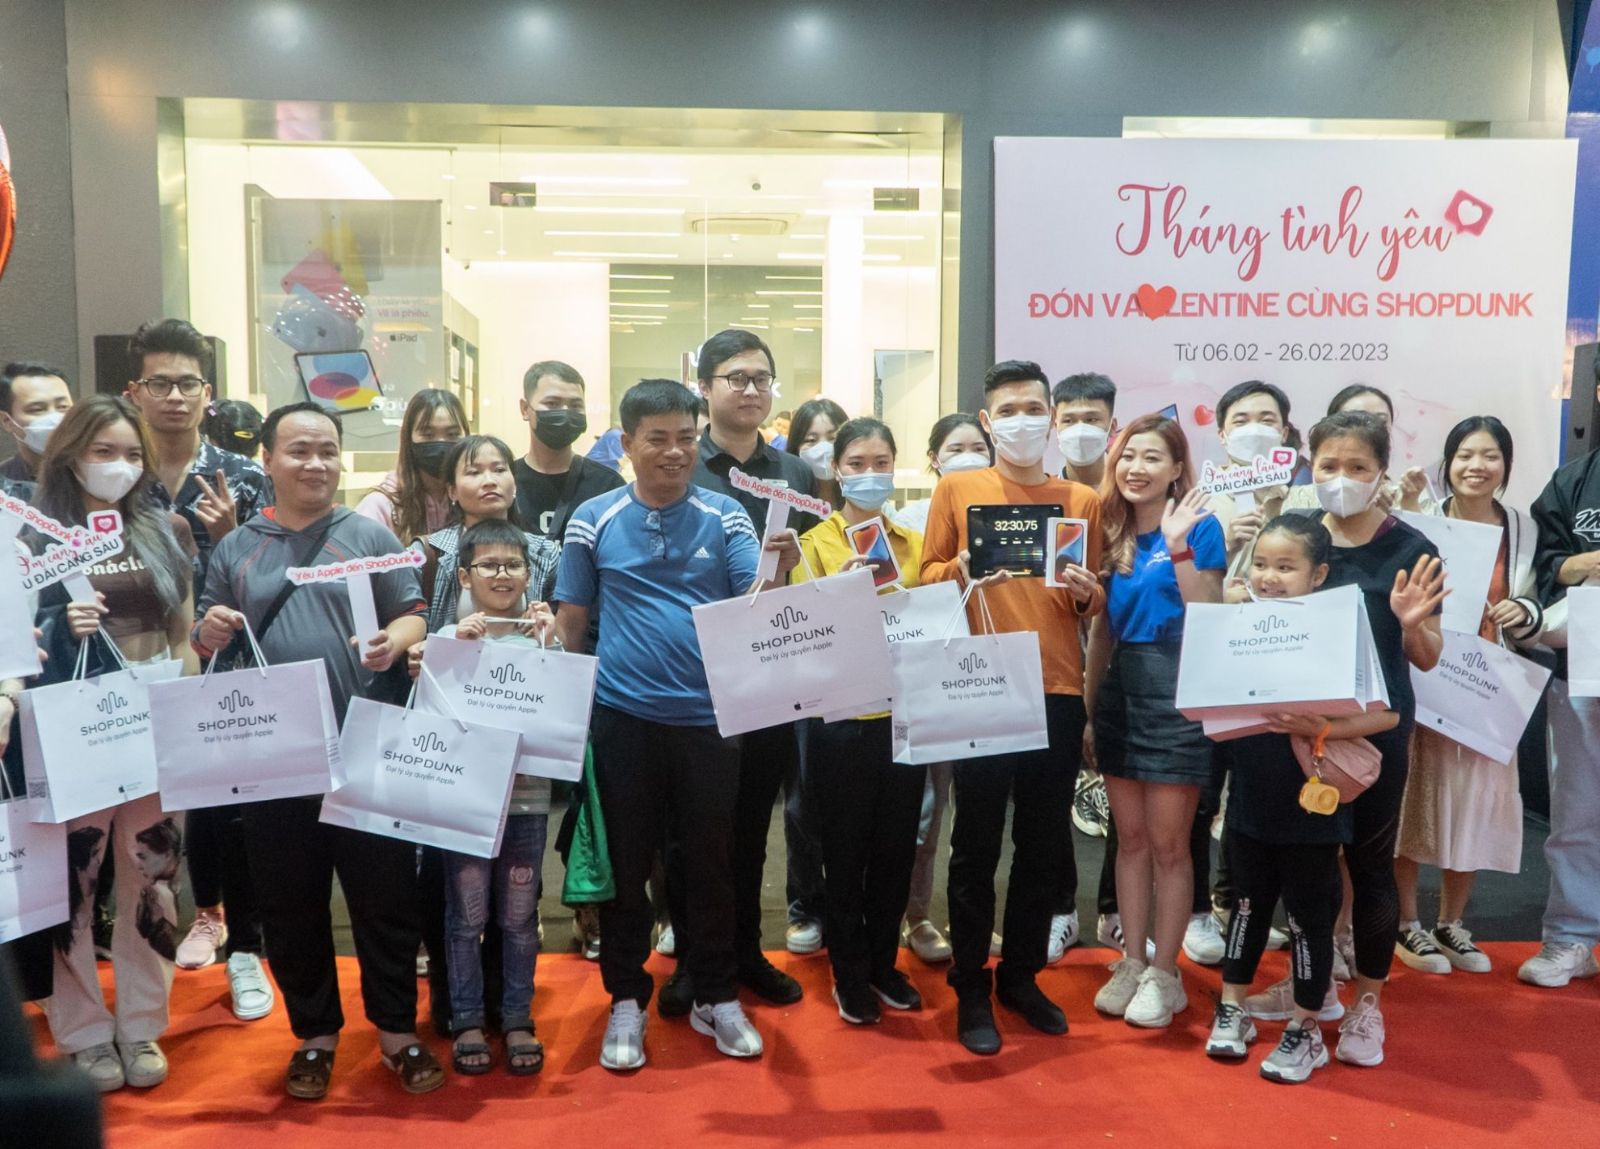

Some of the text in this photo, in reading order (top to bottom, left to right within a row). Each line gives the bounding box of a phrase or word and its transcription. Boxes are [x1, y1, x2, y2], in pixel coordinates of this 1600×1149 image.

[1115, 182, 1453, 282] Tháng tình yêu
[1028, 287, 1093, 318] ĐÓN
[1286, 286, 1369, 318] CÙNG
[1376, 292, 1534, 318] SHOPDUNK
[1173, 342, 1199, 361] Từ
[1202, 343, 1259, 361] 06.02
[1279, 343, 1390, 361] 26.02.2023
[751, 481, 772, 496] Apple
[787, 493, 824, 511] ShopDunk
[25, 510, 73, 541] ShopDunk
[317, 567, 344, 578] Apple
[365, 555, 412, 570] ShopDunk
[751, 624, 836, 653] SHOPDUNK
[887, 628, 925, 643] DUNK
[1228, 632, 1311, 648] SHOPDUNK
[812, 641, 833, 652] Apple
[941, 675, 1008, 690] SHOPDUNK
[1439, 658, 1501, 694] SHOPDUNK
[463, 684, 544, 704] SHOPDUNK
[518, 705, 538, 715] Apple
[80, 711, 151, 736] SHOPDUNK
[197, 713, 277, 732] SHOPDUNK
[383, 750, 465, 776] SHOPDUNK
[435, 775, 456, 786] Apple
